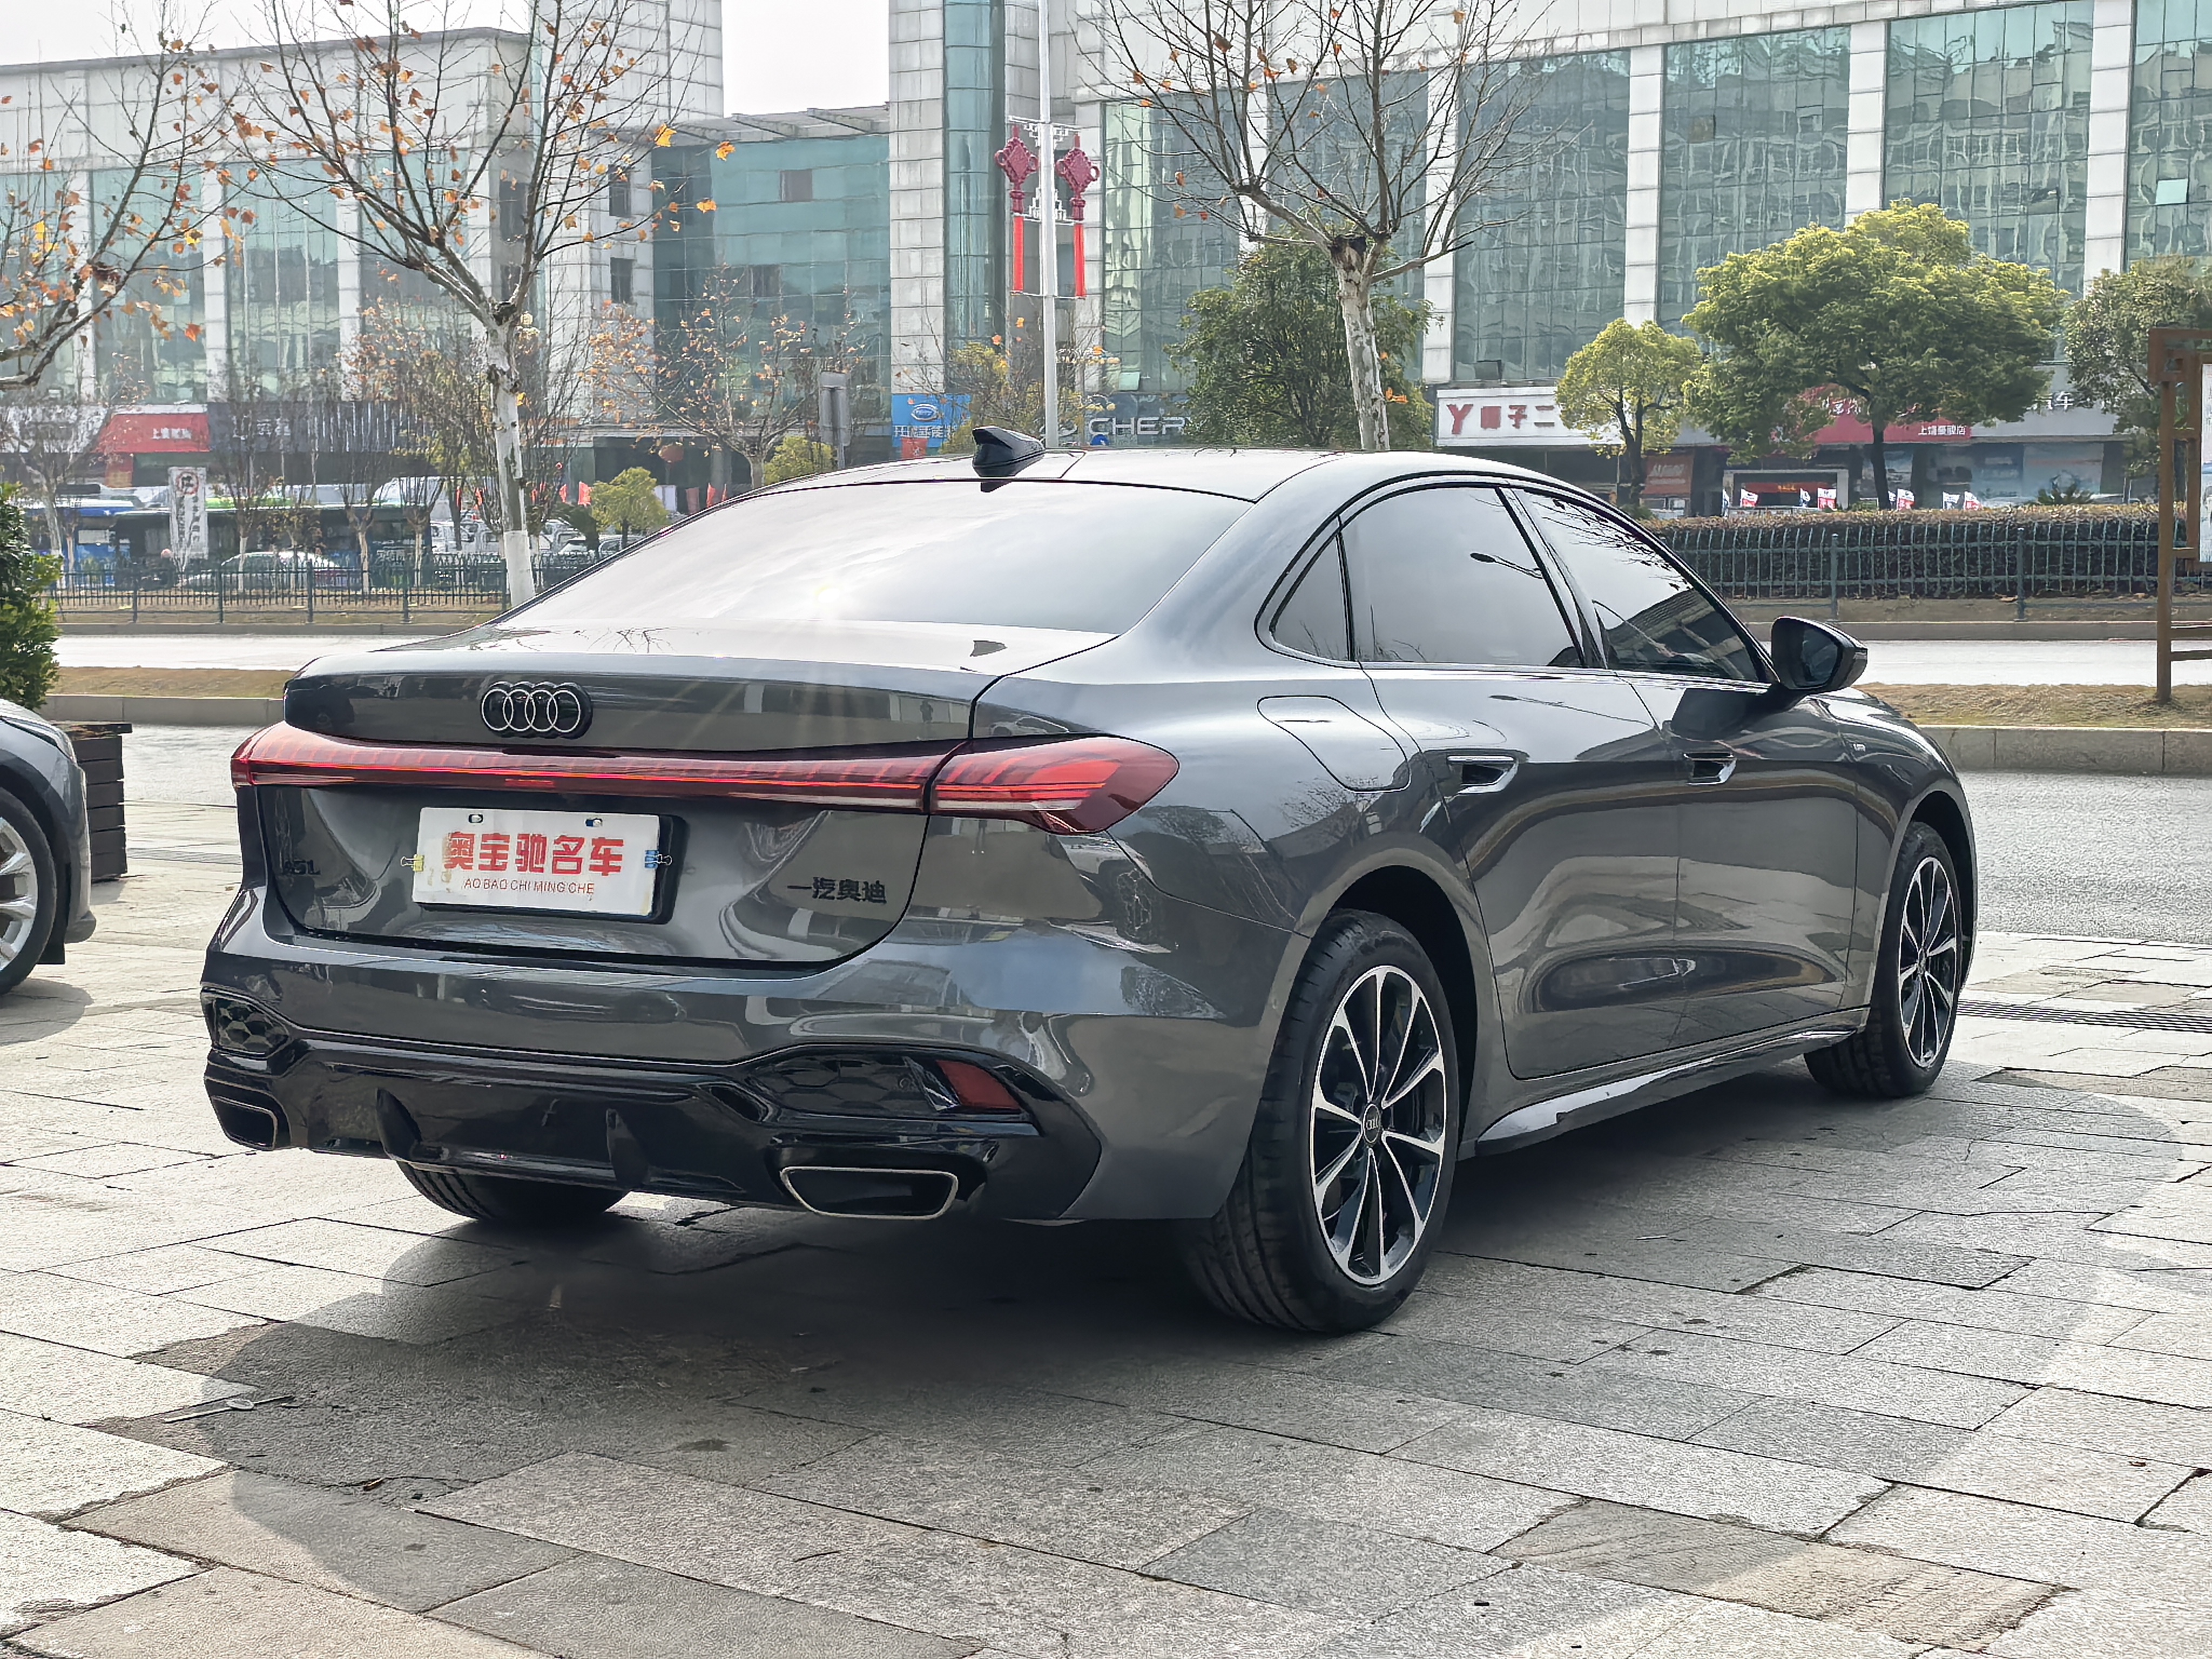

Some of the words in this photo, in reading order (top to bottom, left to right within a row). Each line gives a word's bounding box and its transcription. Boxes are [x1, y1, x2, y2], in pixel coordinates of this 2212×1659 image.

[444, 831, 624, 876] 奥宝驰名车
[787, 876, 887, 904] 一汽奥迪
